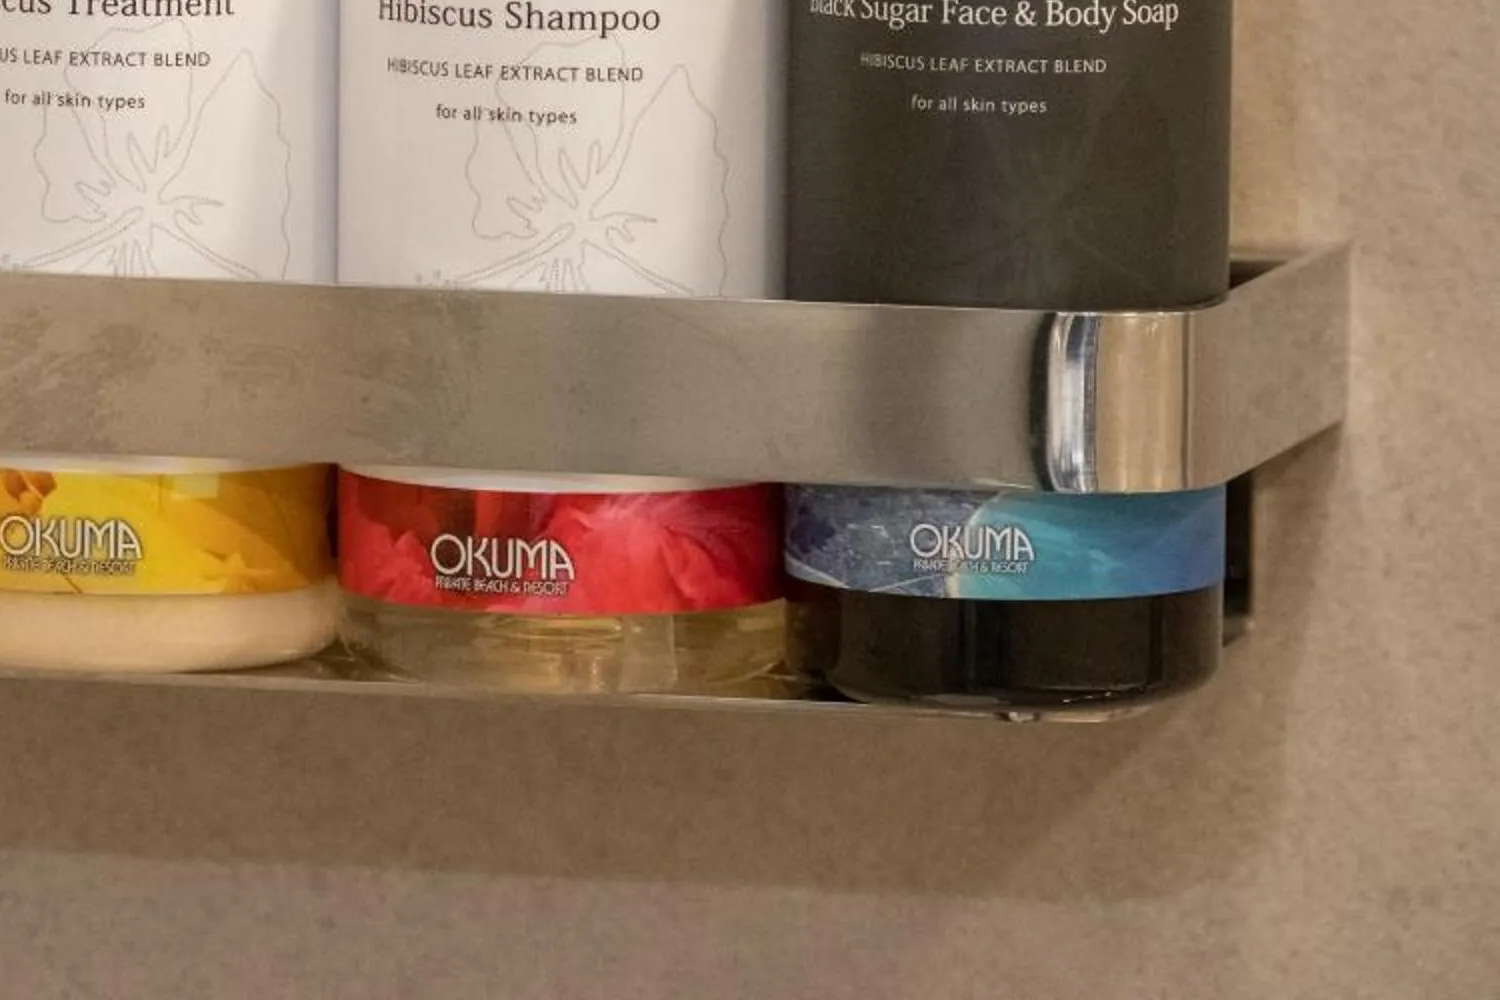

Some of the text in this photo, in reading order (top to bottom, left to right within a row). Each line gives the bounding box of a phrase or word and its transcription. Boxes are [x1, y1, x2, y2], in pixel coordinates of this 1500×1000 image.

[504, 1, 661, 38] Shampoo
[1014, 0, 1038, 27] &
[23, 49, 63, 66] LEAF
[69, 51, 146, 68] EXTRACT
[153, 51, 211, 68] BLEND
[386, 57, 644, 83] HIBISCUS LEAF EXTRACT BLEND
[860, 52, 1107, 74] HIBISCUS LEAF EXTRACT BLEND
[5, 88, 145, 112] for all skin types
[911, 94, 1047, 116] for all skin types
[435, 103, 577, 127] for all skin types
[909, 523, 1035, 561] OKUMA
[431, 533, 574, 580] OKUMA
